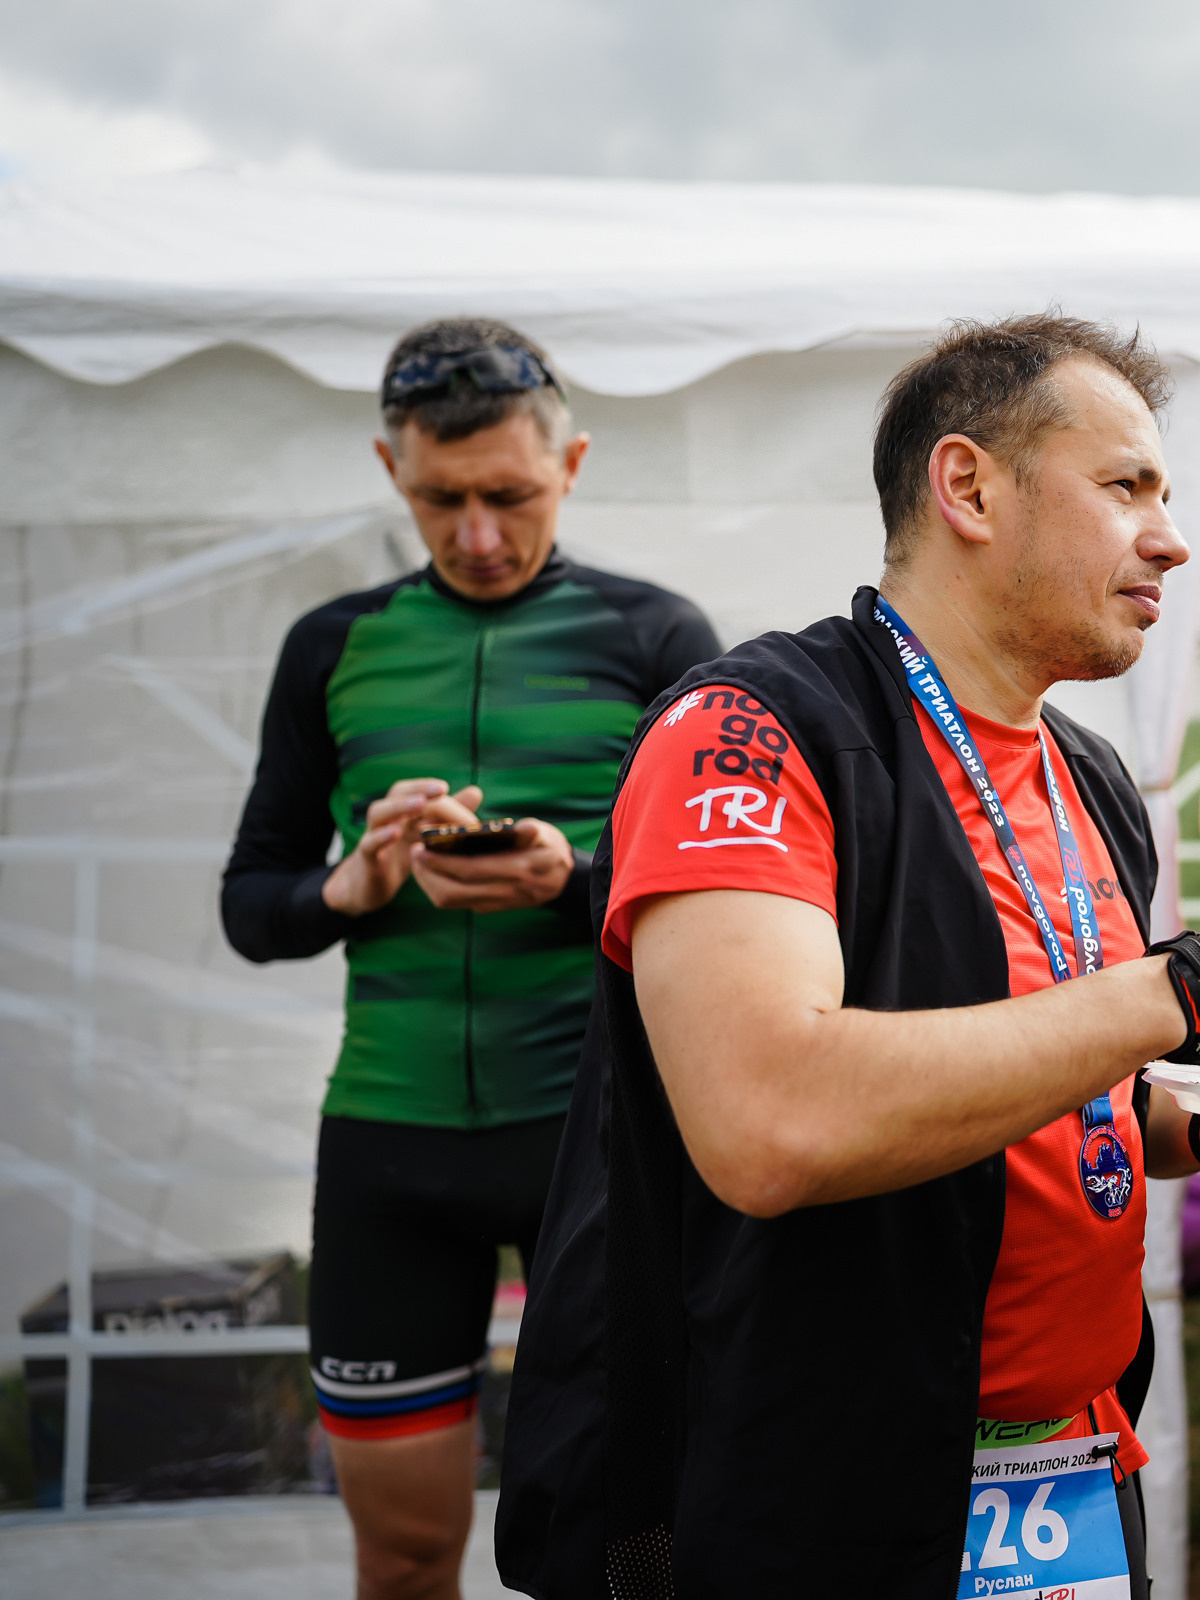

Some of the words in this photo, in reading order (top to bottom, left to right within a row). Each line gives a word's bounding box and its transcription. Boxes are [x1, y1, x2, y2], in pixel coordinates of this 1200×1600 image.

[718, 714, 789, 754] go
[918, 673, 980, 773] ТРИАТЛОН
[976, 777, 1005, 827] 2023
[685, 785, 788, 835] TRI
[1003, 1456, 1070, 1475] ТРИАТЛОН
[961, 1482, 1069, 1572] 26
[974, 1574, 1034, 1596] Руслан
